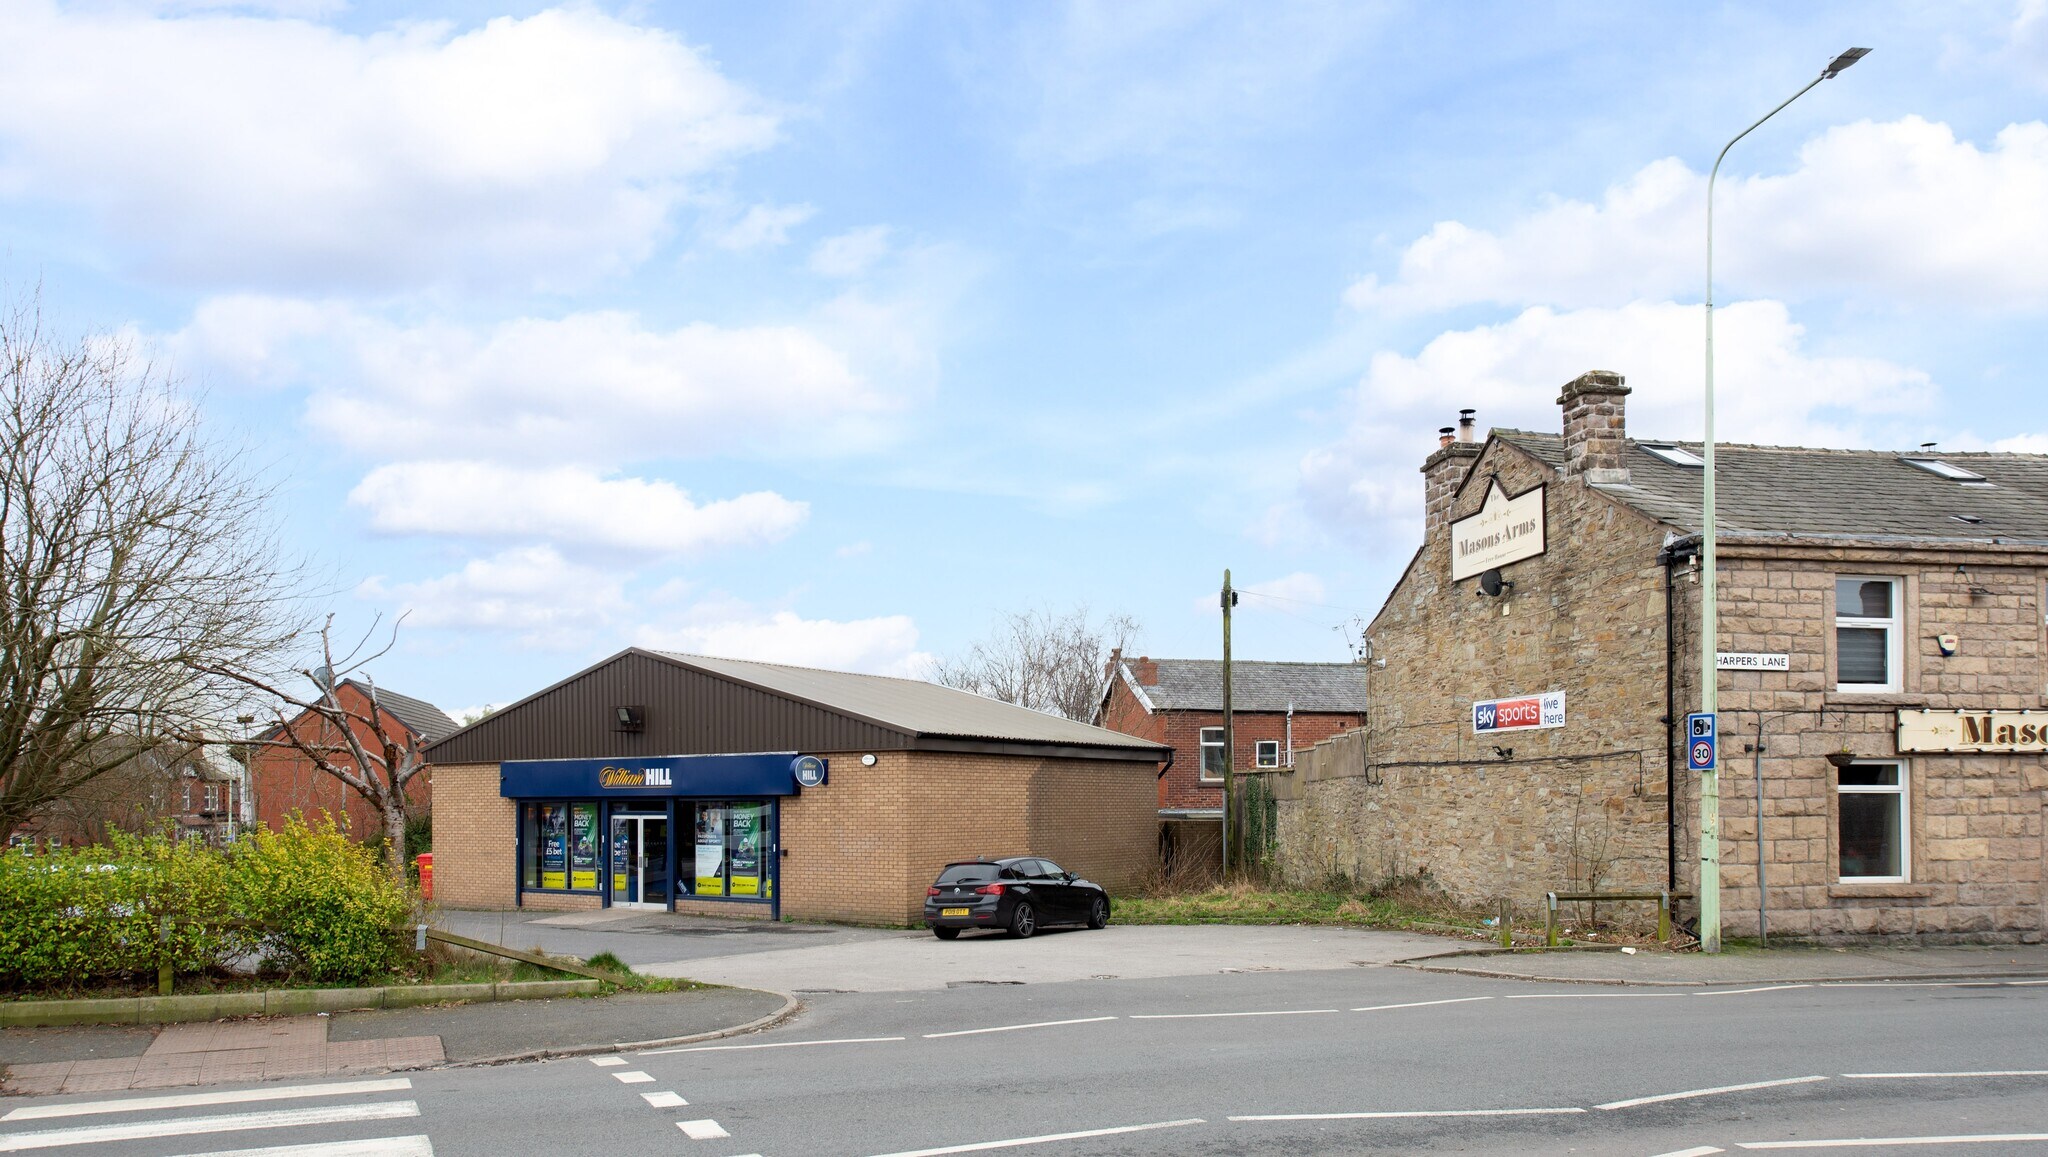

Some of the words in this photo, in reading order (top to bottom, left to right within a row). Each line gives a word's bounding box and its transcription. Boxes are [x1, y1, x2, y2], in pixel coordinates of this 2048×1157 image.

[1458, 532, 1500, 559] Masons
[1502, 518, 1536, 544] Arms
[1716, 656, 1758, 666] HARPERS
[1762, 657, 1786, 666] LANE
[1544, 698, 1558, 710] live
[1478, 706, 1496, 727] sky
[1498, 704, 1538, 725] sports
[1544, 712, 1564, 724] here
[1694, 748, 1709, 759] 30
[599, 766, 645, 788] William
[646, 768, 672, 786] HILL
[802, 770, 818, 780] HILL
